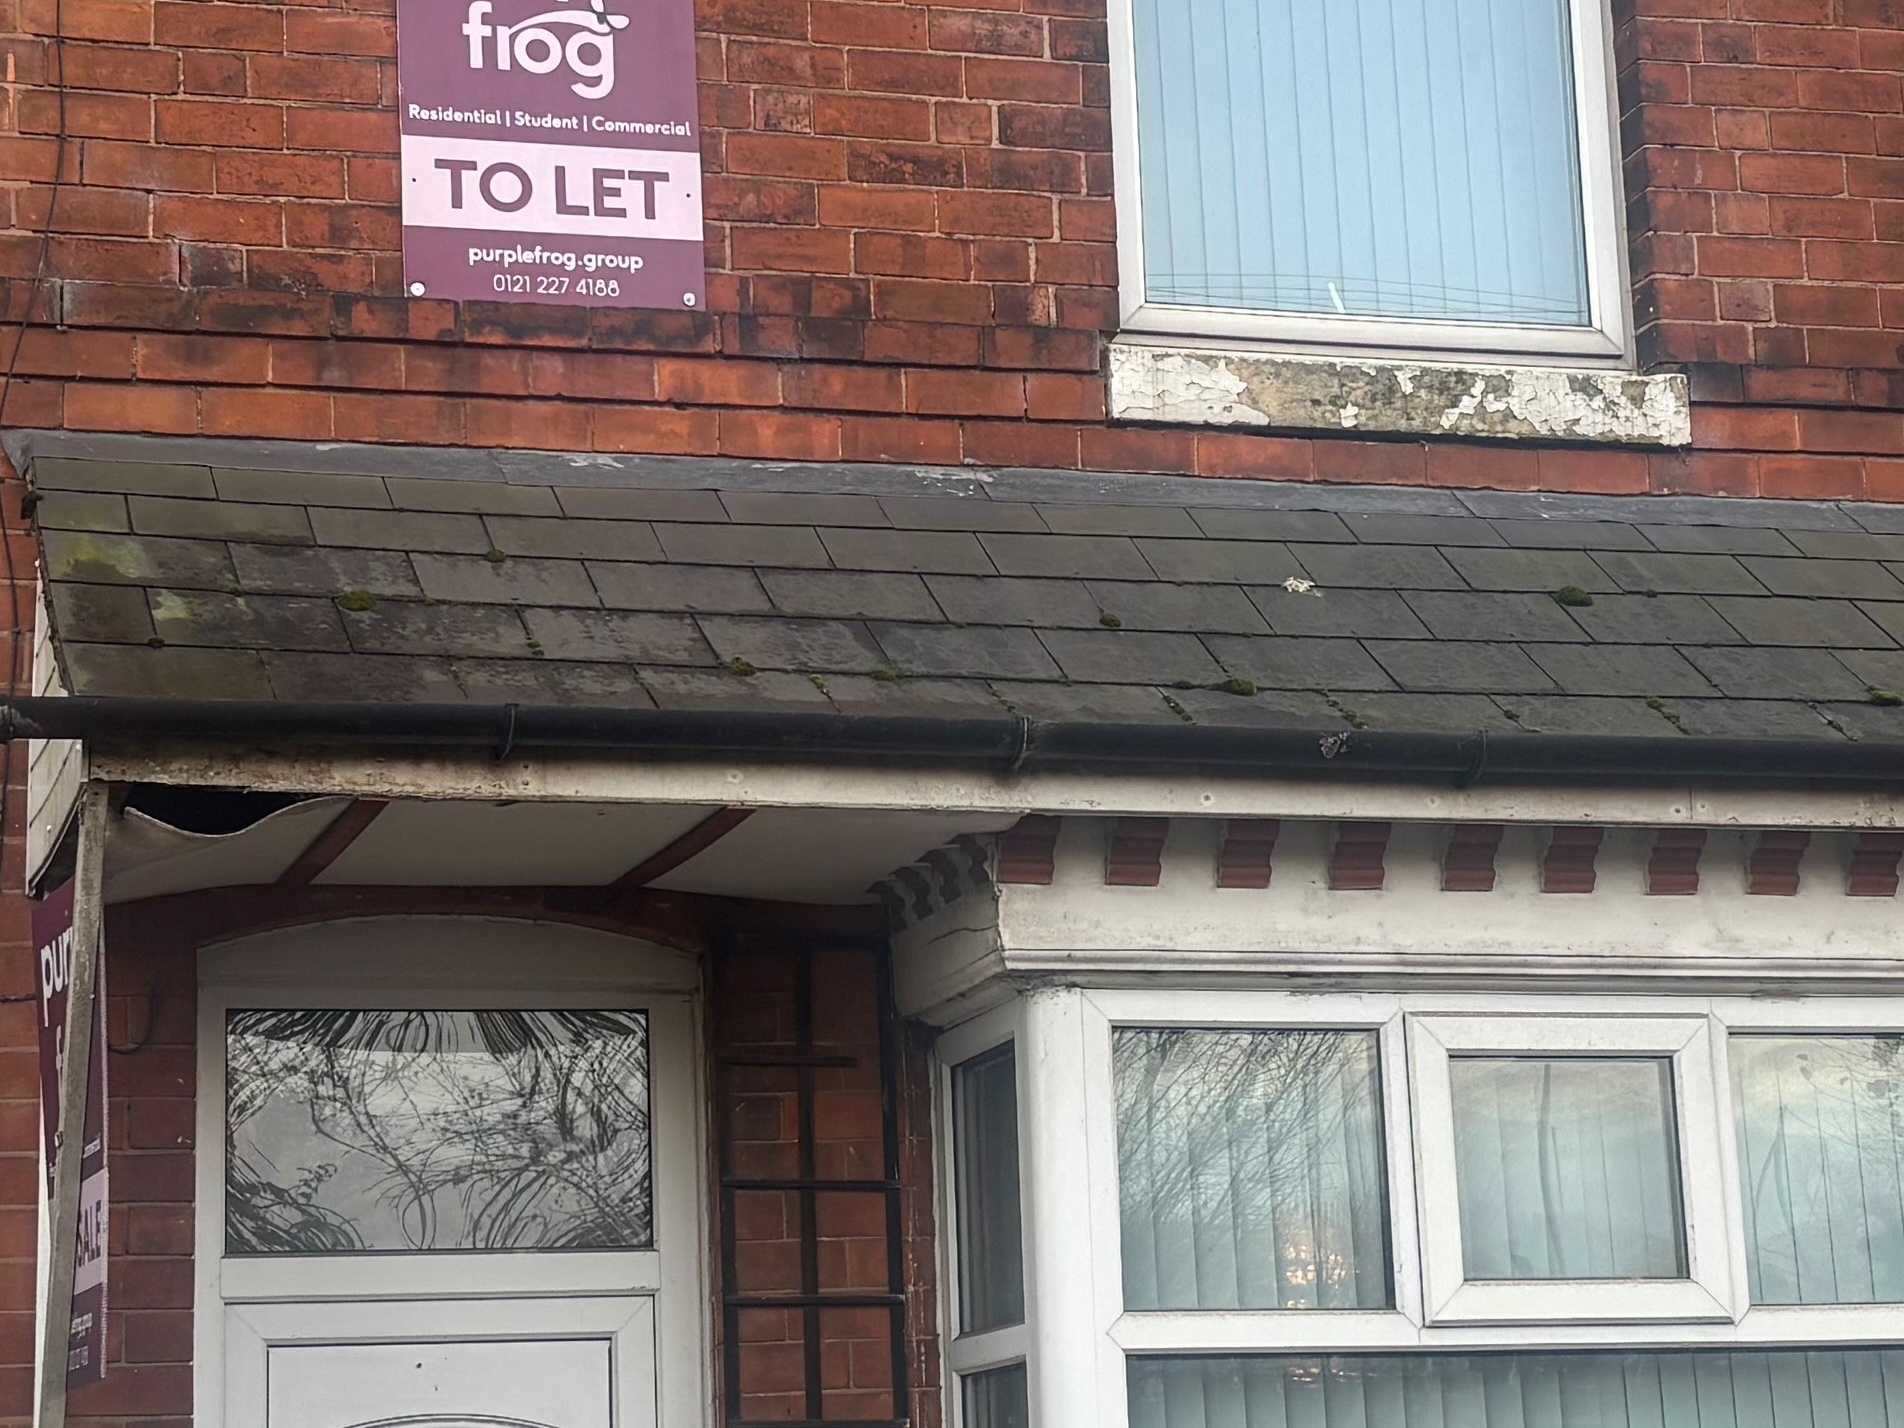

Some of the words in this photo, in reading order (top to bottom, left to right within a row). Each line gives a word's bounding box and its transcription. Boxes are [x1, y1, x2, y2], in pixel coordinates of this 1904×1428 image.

[461, 0, 617, 99] frog
[408, 104, 501, 124] Residential
[514, 111, 578, 130] Student
[592, 116, 692, 137] Commercial
[434, 158, 533, 213] TO
[554, 165, 670, 220] LET
[468, 245, 644, 274] purplefrog.group
[493, 274, 531, 292] 0121
[536, 277, 569, 294] 227
[575, 279, 620, 297] 4188
